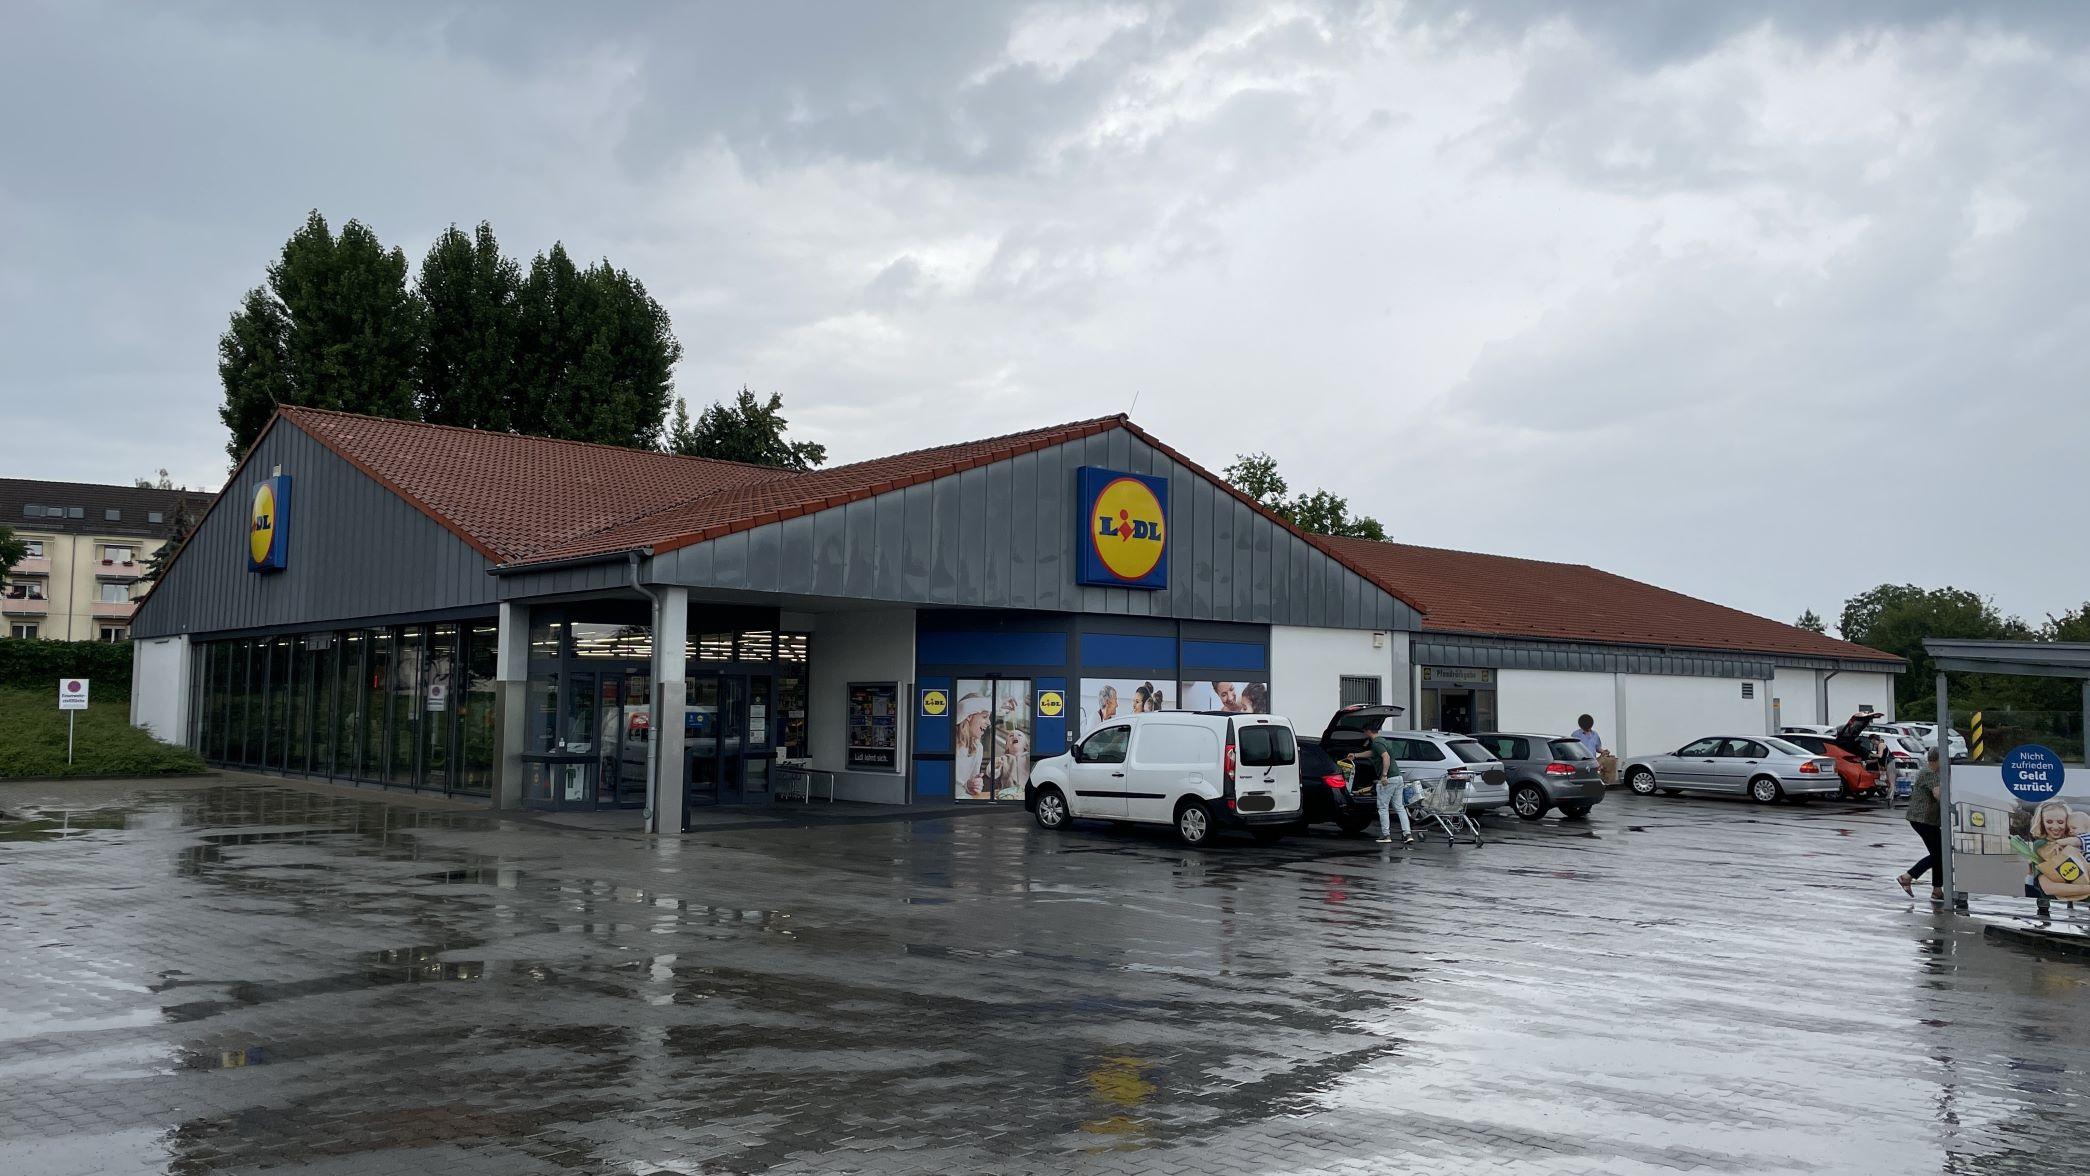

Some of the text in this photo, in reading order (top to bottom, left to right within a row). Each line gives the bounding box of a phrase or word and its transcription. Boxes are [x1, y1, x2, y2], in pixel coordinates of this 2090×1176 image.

[2020, 752, 2044, 760] Nicht
[2011, 761, 2053, 770] zufrieden
[2019, 770, 2047, 780] Geld
[2013, 782, 2053, 792] zurück
